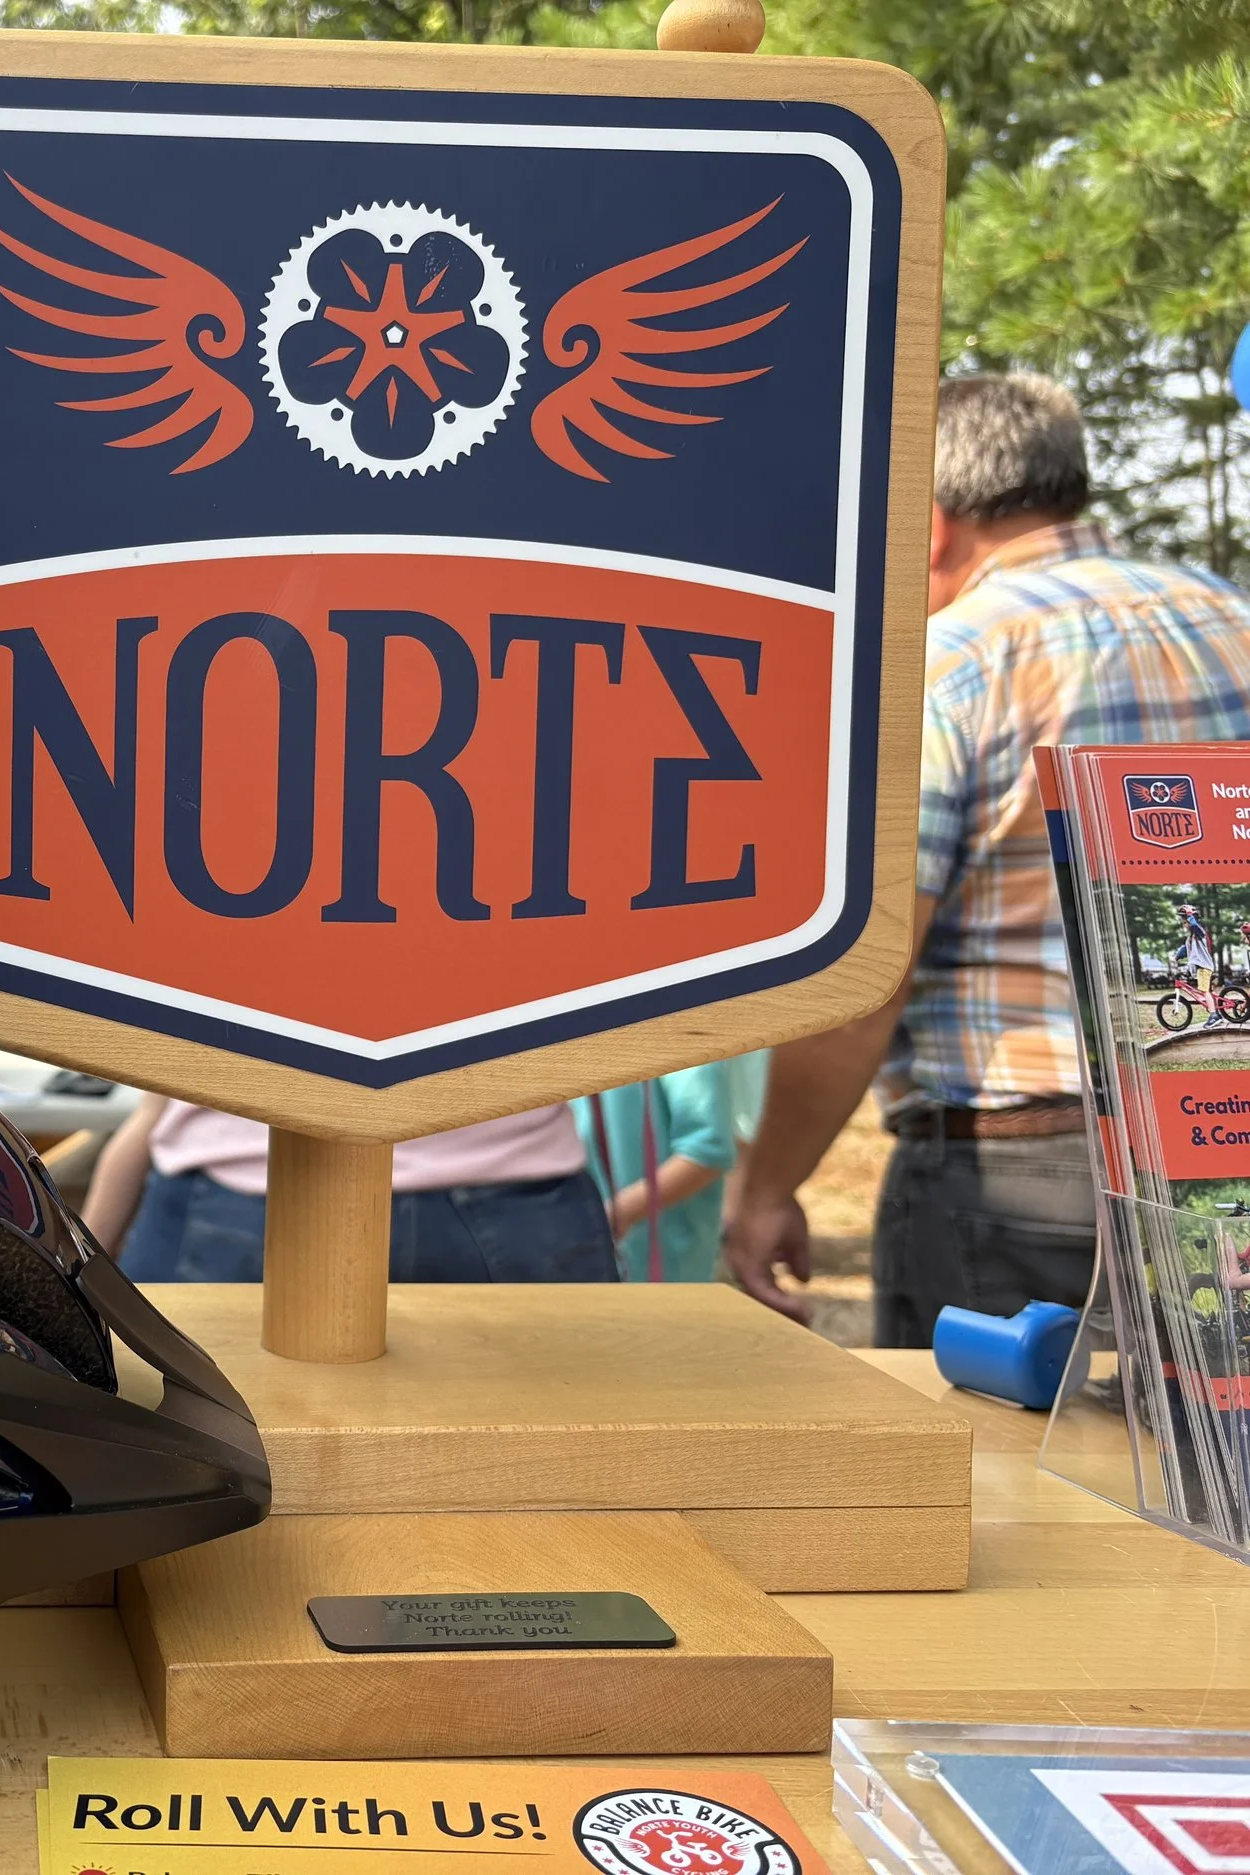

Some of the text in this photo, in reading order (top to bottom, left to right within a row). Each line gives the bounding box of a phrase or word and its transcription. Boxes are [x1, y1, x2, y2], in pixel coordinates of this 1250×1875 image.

[1211, 782, 1250, 799] Nort
[1136, 812, 1195, 837] NORTE
[1191, 1126, 1209, 1146] &
[382, 1598, 577, 1612] Your gift keeps
[404, 1611, 573, 1624] Norte rolling!
[426, 1625, 573, 1637] Thank you
[73, 1793, 548, 1840] Roll With Us!
[589, 1797, 760, 1840] BALANCE BIKE
[636, 1820, 718, 1839] NORTE YOUTH
